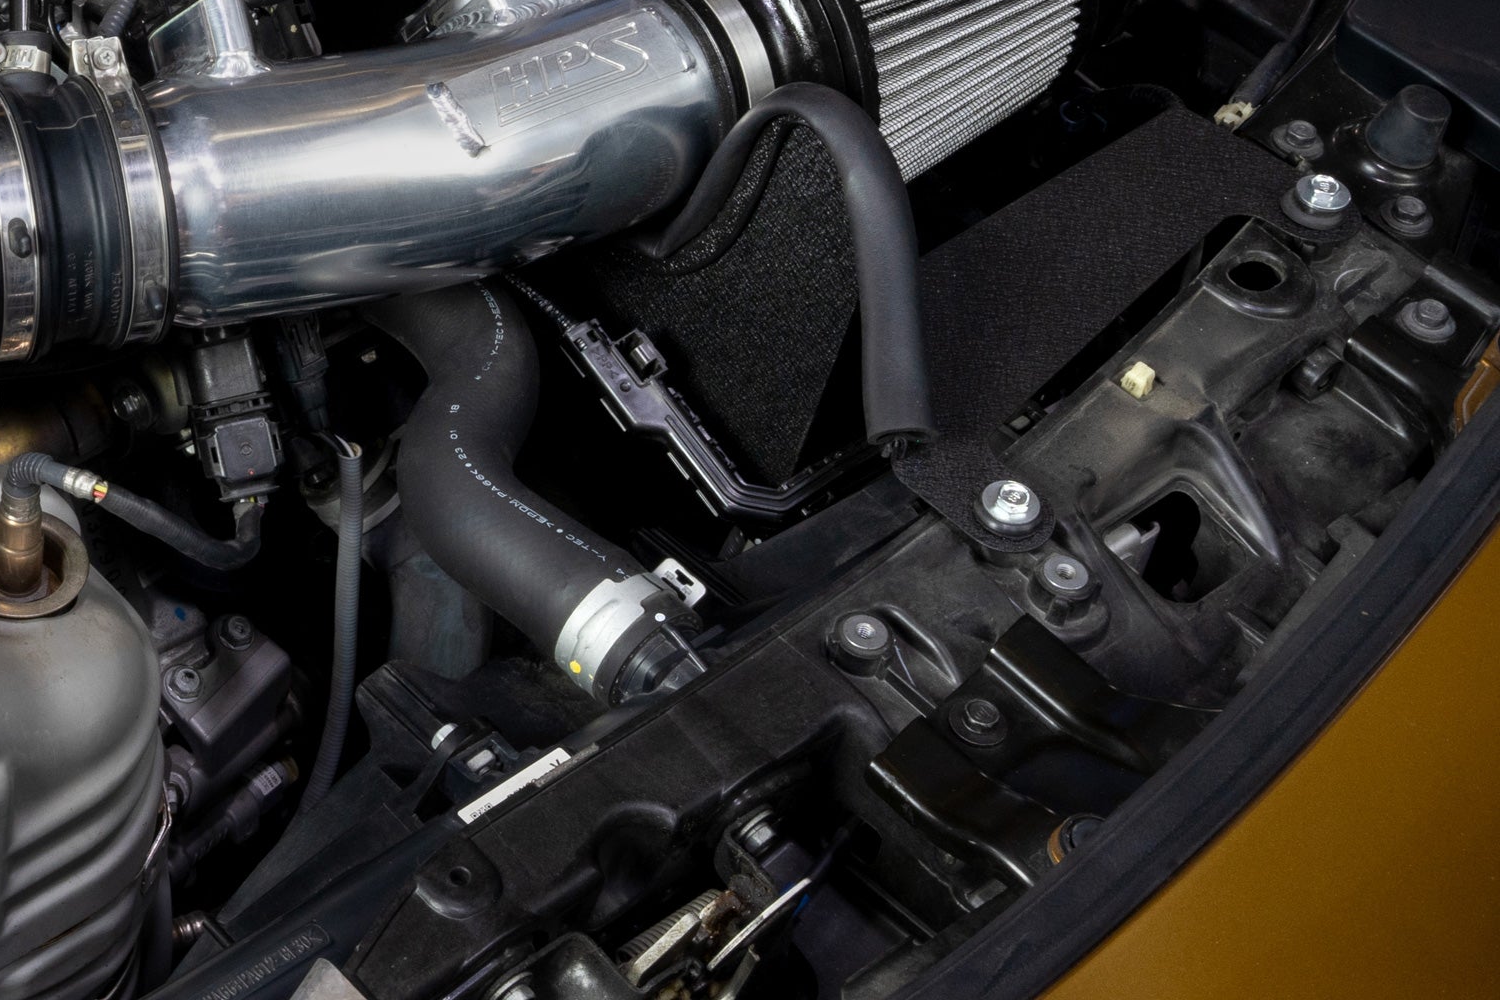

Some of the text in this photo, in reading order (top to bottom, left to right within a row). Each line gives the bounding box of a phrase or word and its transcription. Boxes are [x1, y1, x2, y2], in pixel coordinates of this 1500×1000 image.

[489, 22, 649, 127] HPS
[490, 328, 504, 356] Y-TEC
[450, 404, 460, 413] 18
[450, 429, 458, 440] 01
[455, 447, 467, 460] 23
[565, 533, 606, 562] Y-TEC
